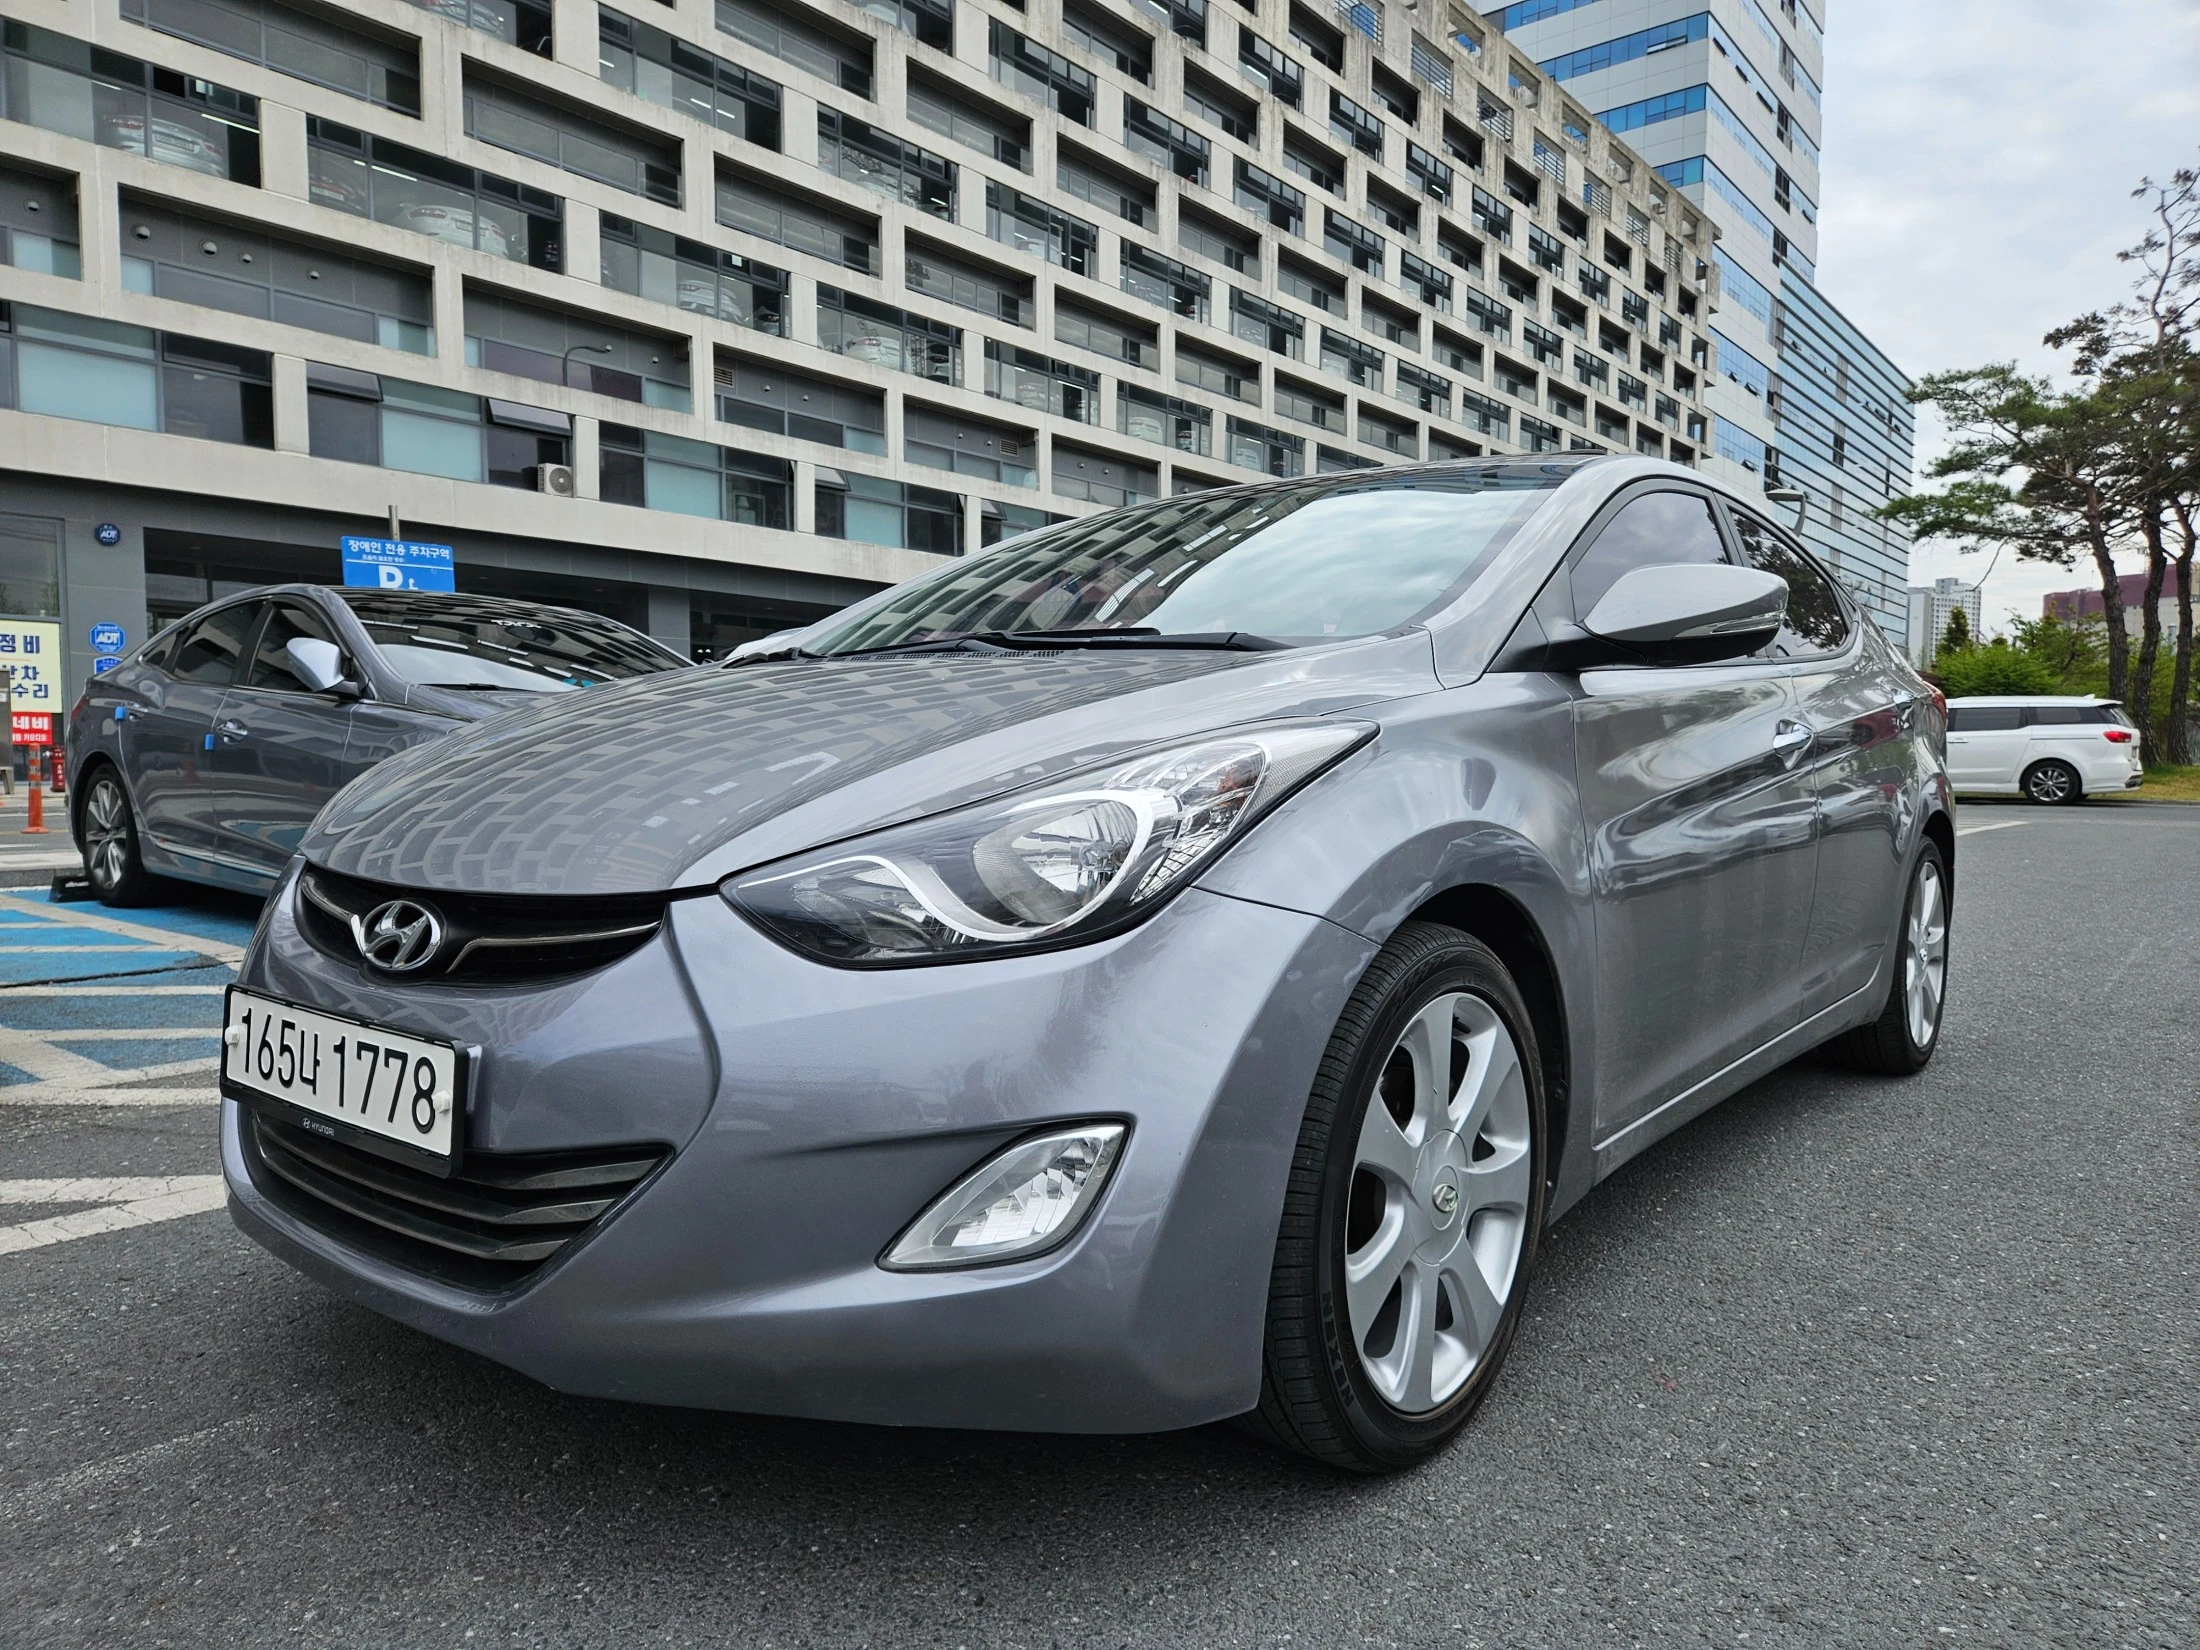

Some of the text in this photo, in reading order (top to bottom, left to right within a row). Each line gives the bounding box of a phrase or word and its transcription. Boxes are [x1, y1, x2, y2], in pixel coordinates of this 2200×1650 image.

[348, 540, 381, 553] 장애인
[385, 543, 406, 556] 전용
[409, 546, 450, 559] 주차구역
[96, 632, 119, 644] ADT
[11, 684, 49, 698] 수리
[12, 716, 49, 730] 네비
[241, 1007, 437, 1134] 165나 1778
[311, 1122, 335, 1136] HYUNDAI
[1322, 1291, 1355, 1407] NEXEN
